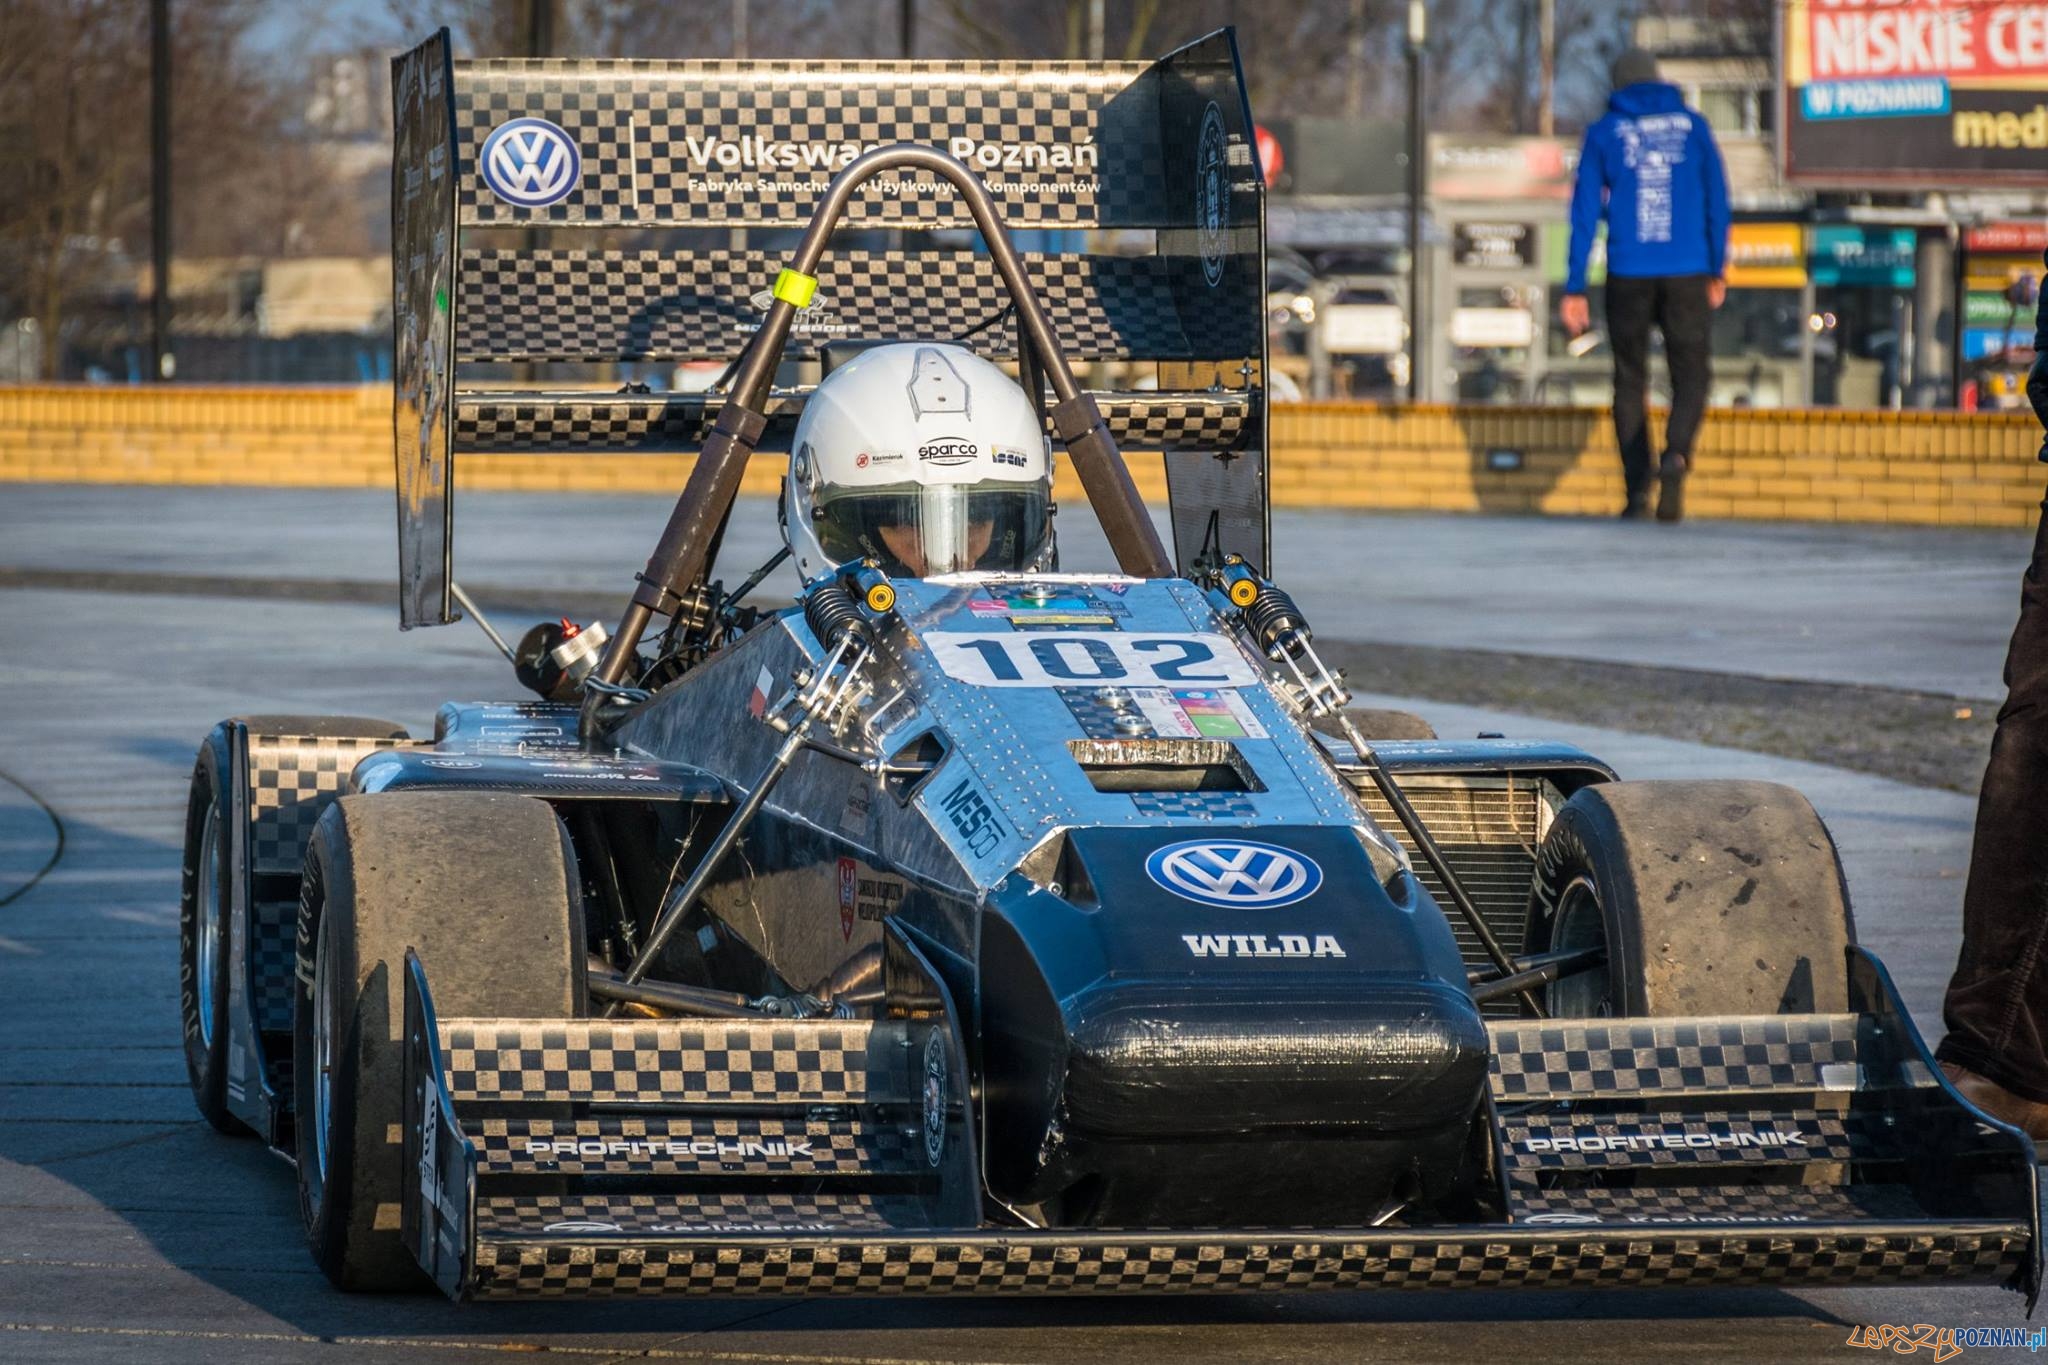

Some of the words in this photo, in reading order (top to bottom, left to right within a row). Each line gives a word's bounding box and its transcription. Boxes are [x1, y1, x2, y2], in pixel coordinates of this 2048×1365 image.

[1814, 9, 1977, 74] NISKIE
[1837, 78, 1945, 113] POZNANIU
[685, 135, 882, 168] Volkswa
[950, 136, 1099, 167] Poznań
[688, 179, 754, 194] Fabryka
[757, 178, 868, 192] Samochow
[871, 177, 960, 195] Użytkowyc
[983, 177, 1102, 196] Komponentów
[918, 443, 978, 461] sparco
[957, 638, 1230, 681] 102
[940, 778, 1007, 860] MESCO
[1181, 934, 1347, 958] WILDA
[525, 1141, 816, 1157] PROFITECHNIK
[1525, 1131, 1808, 1152] PROFITECHNIK
